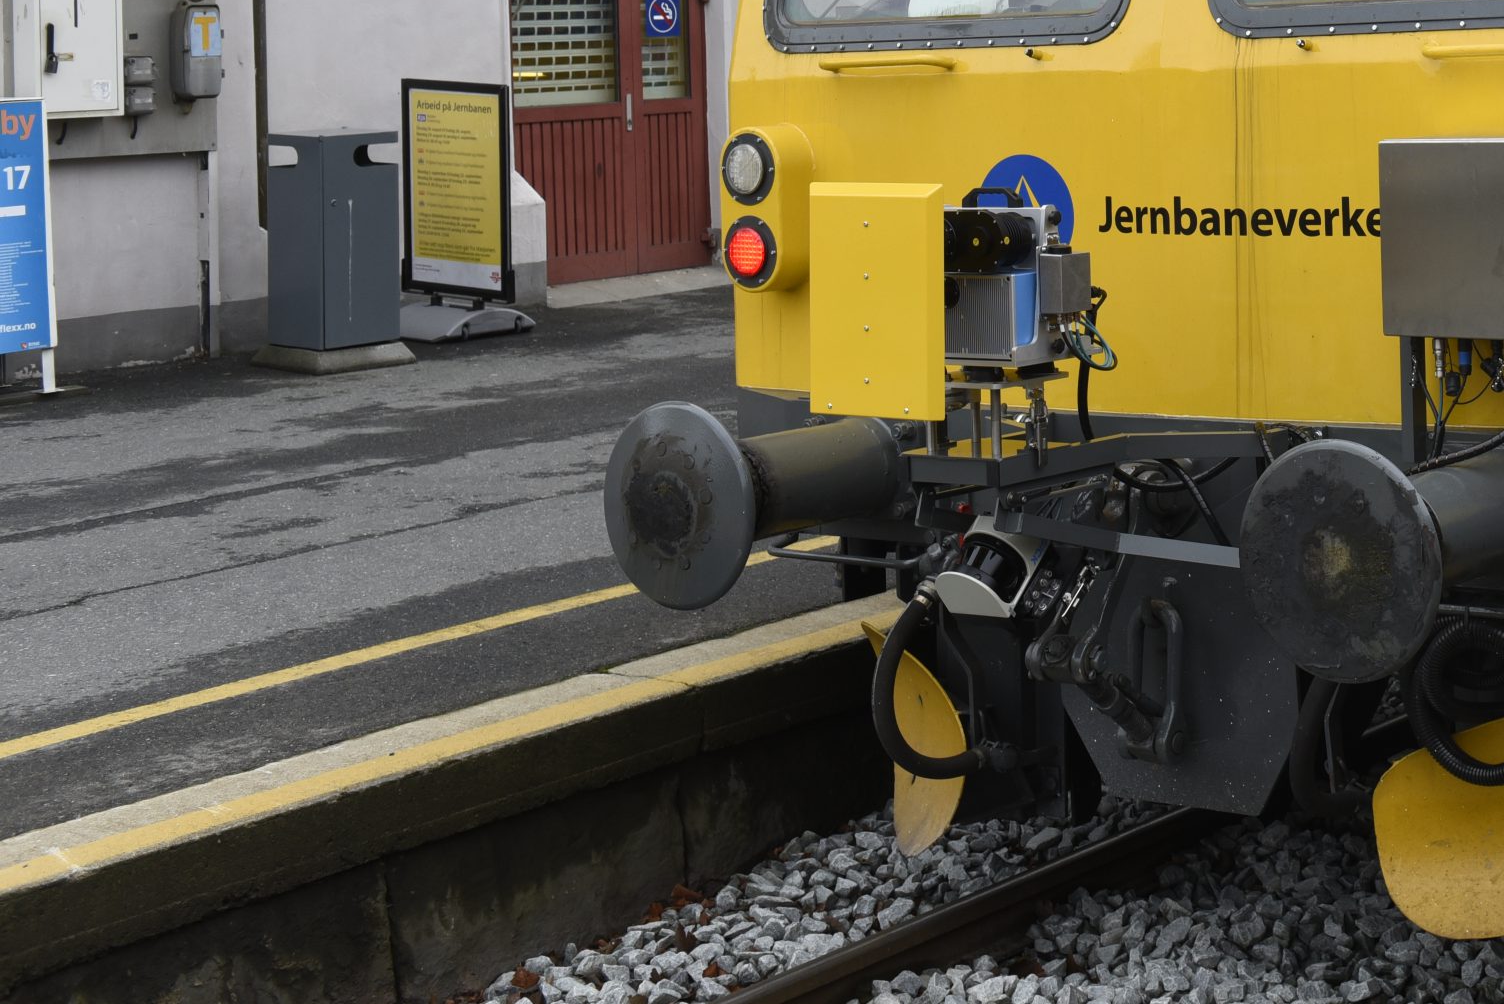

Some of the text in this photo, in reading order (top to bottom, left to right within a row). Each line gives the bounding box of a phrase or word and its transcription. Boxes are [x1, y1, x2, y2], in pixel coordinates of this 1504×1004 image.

[193, 16, 216, 51] T
[416, 99, 492, 114] Arbeid på Jernbanen
[3, 164, 31, 191] 17
